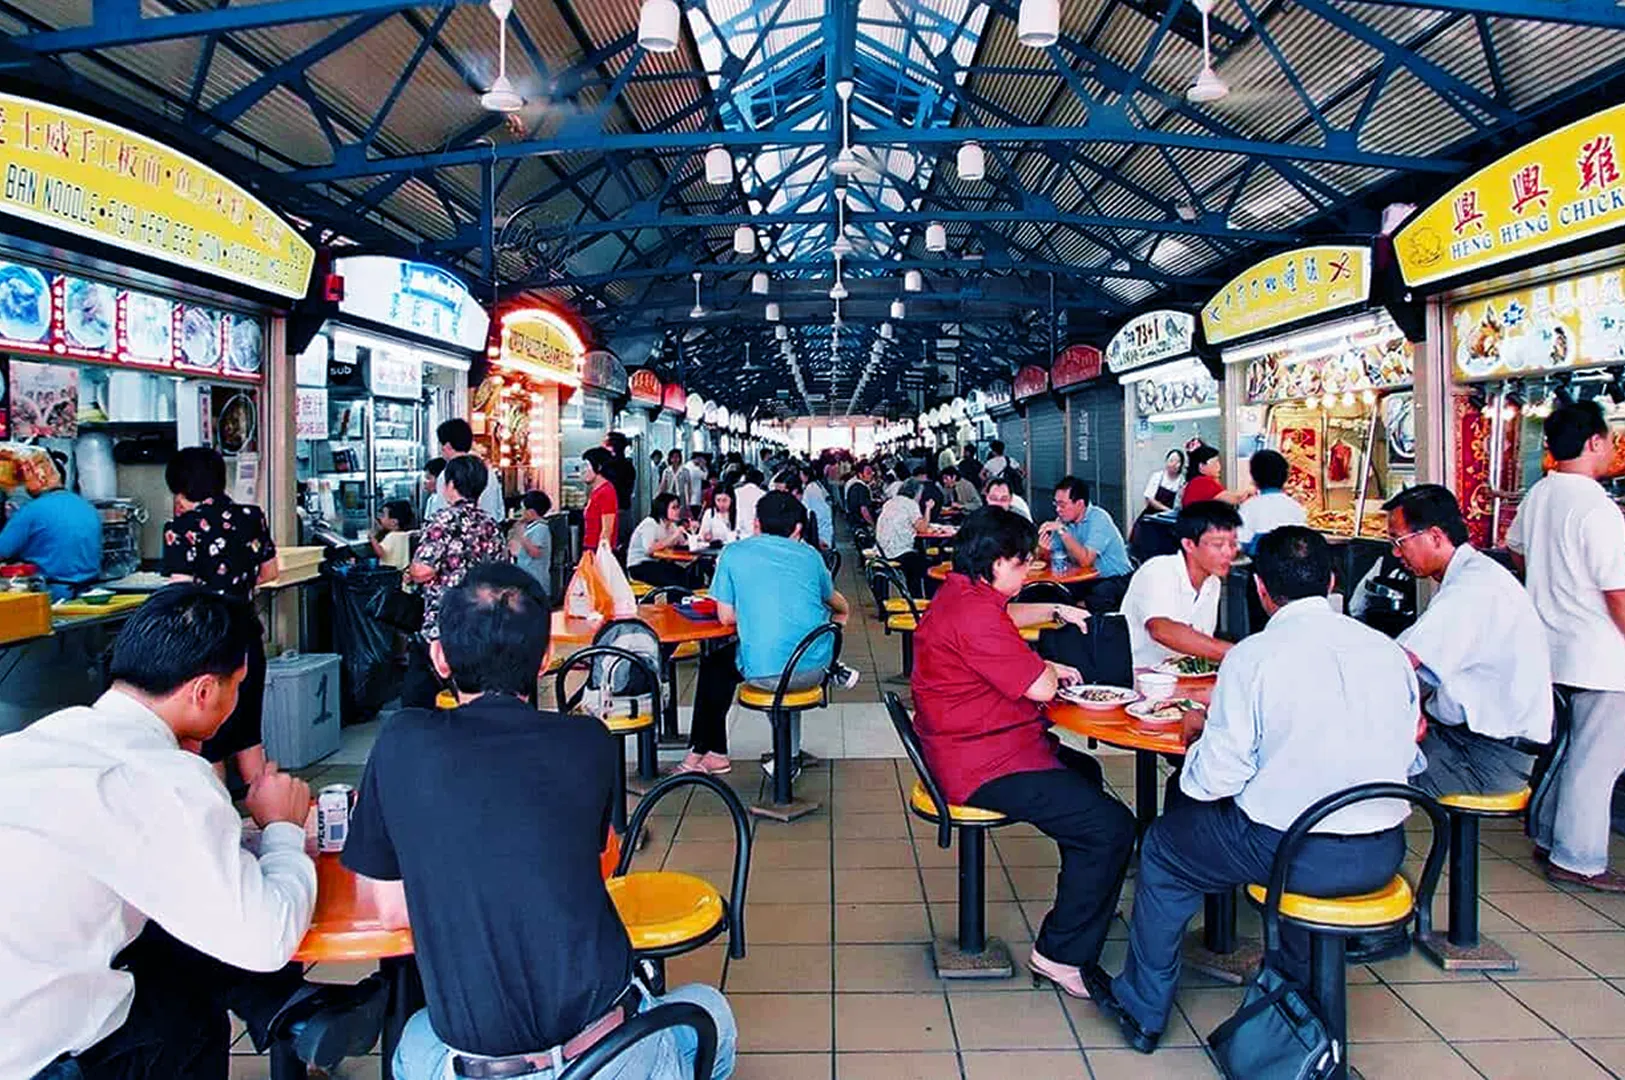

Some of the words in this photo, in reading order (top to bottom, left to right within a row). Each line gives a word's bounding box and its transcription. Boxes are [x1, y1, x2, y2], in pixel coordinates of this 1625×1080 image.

[6, 163, 38, 205] BAN
[1452, 233, 1493, 260] HENG
[1501, 214, 1549, 244] HENG
[315, 673, 333, 725] 1
